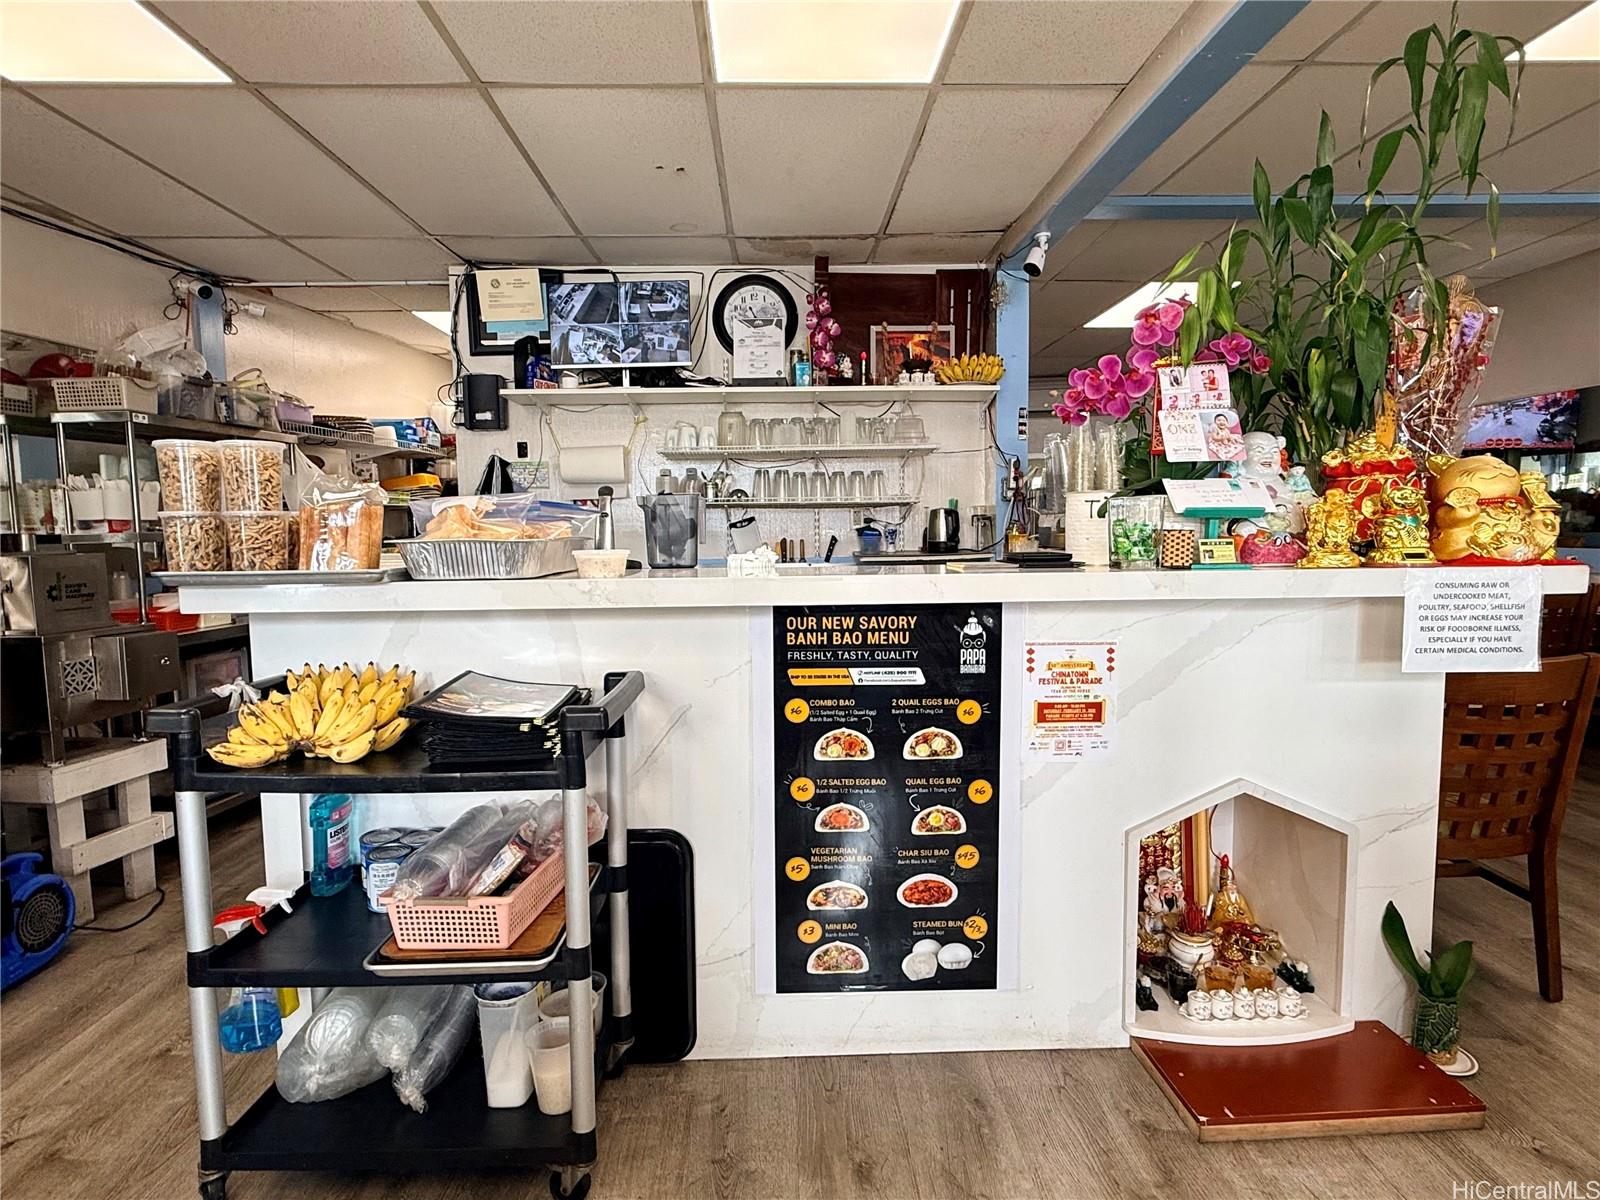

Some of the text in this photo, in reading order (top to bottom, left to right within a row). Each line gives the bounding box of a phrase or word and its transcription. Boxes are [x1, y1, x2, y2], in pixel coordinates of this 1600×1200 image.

[786, 616, 917, 630] OUR NEW SAVORY
[786, 632, 910, 645] BANH BAO MENU
[787, 650, 919, 660] FRESHLY, TASTY, QUALITY
[960, 648, 986, 664] PAPA
